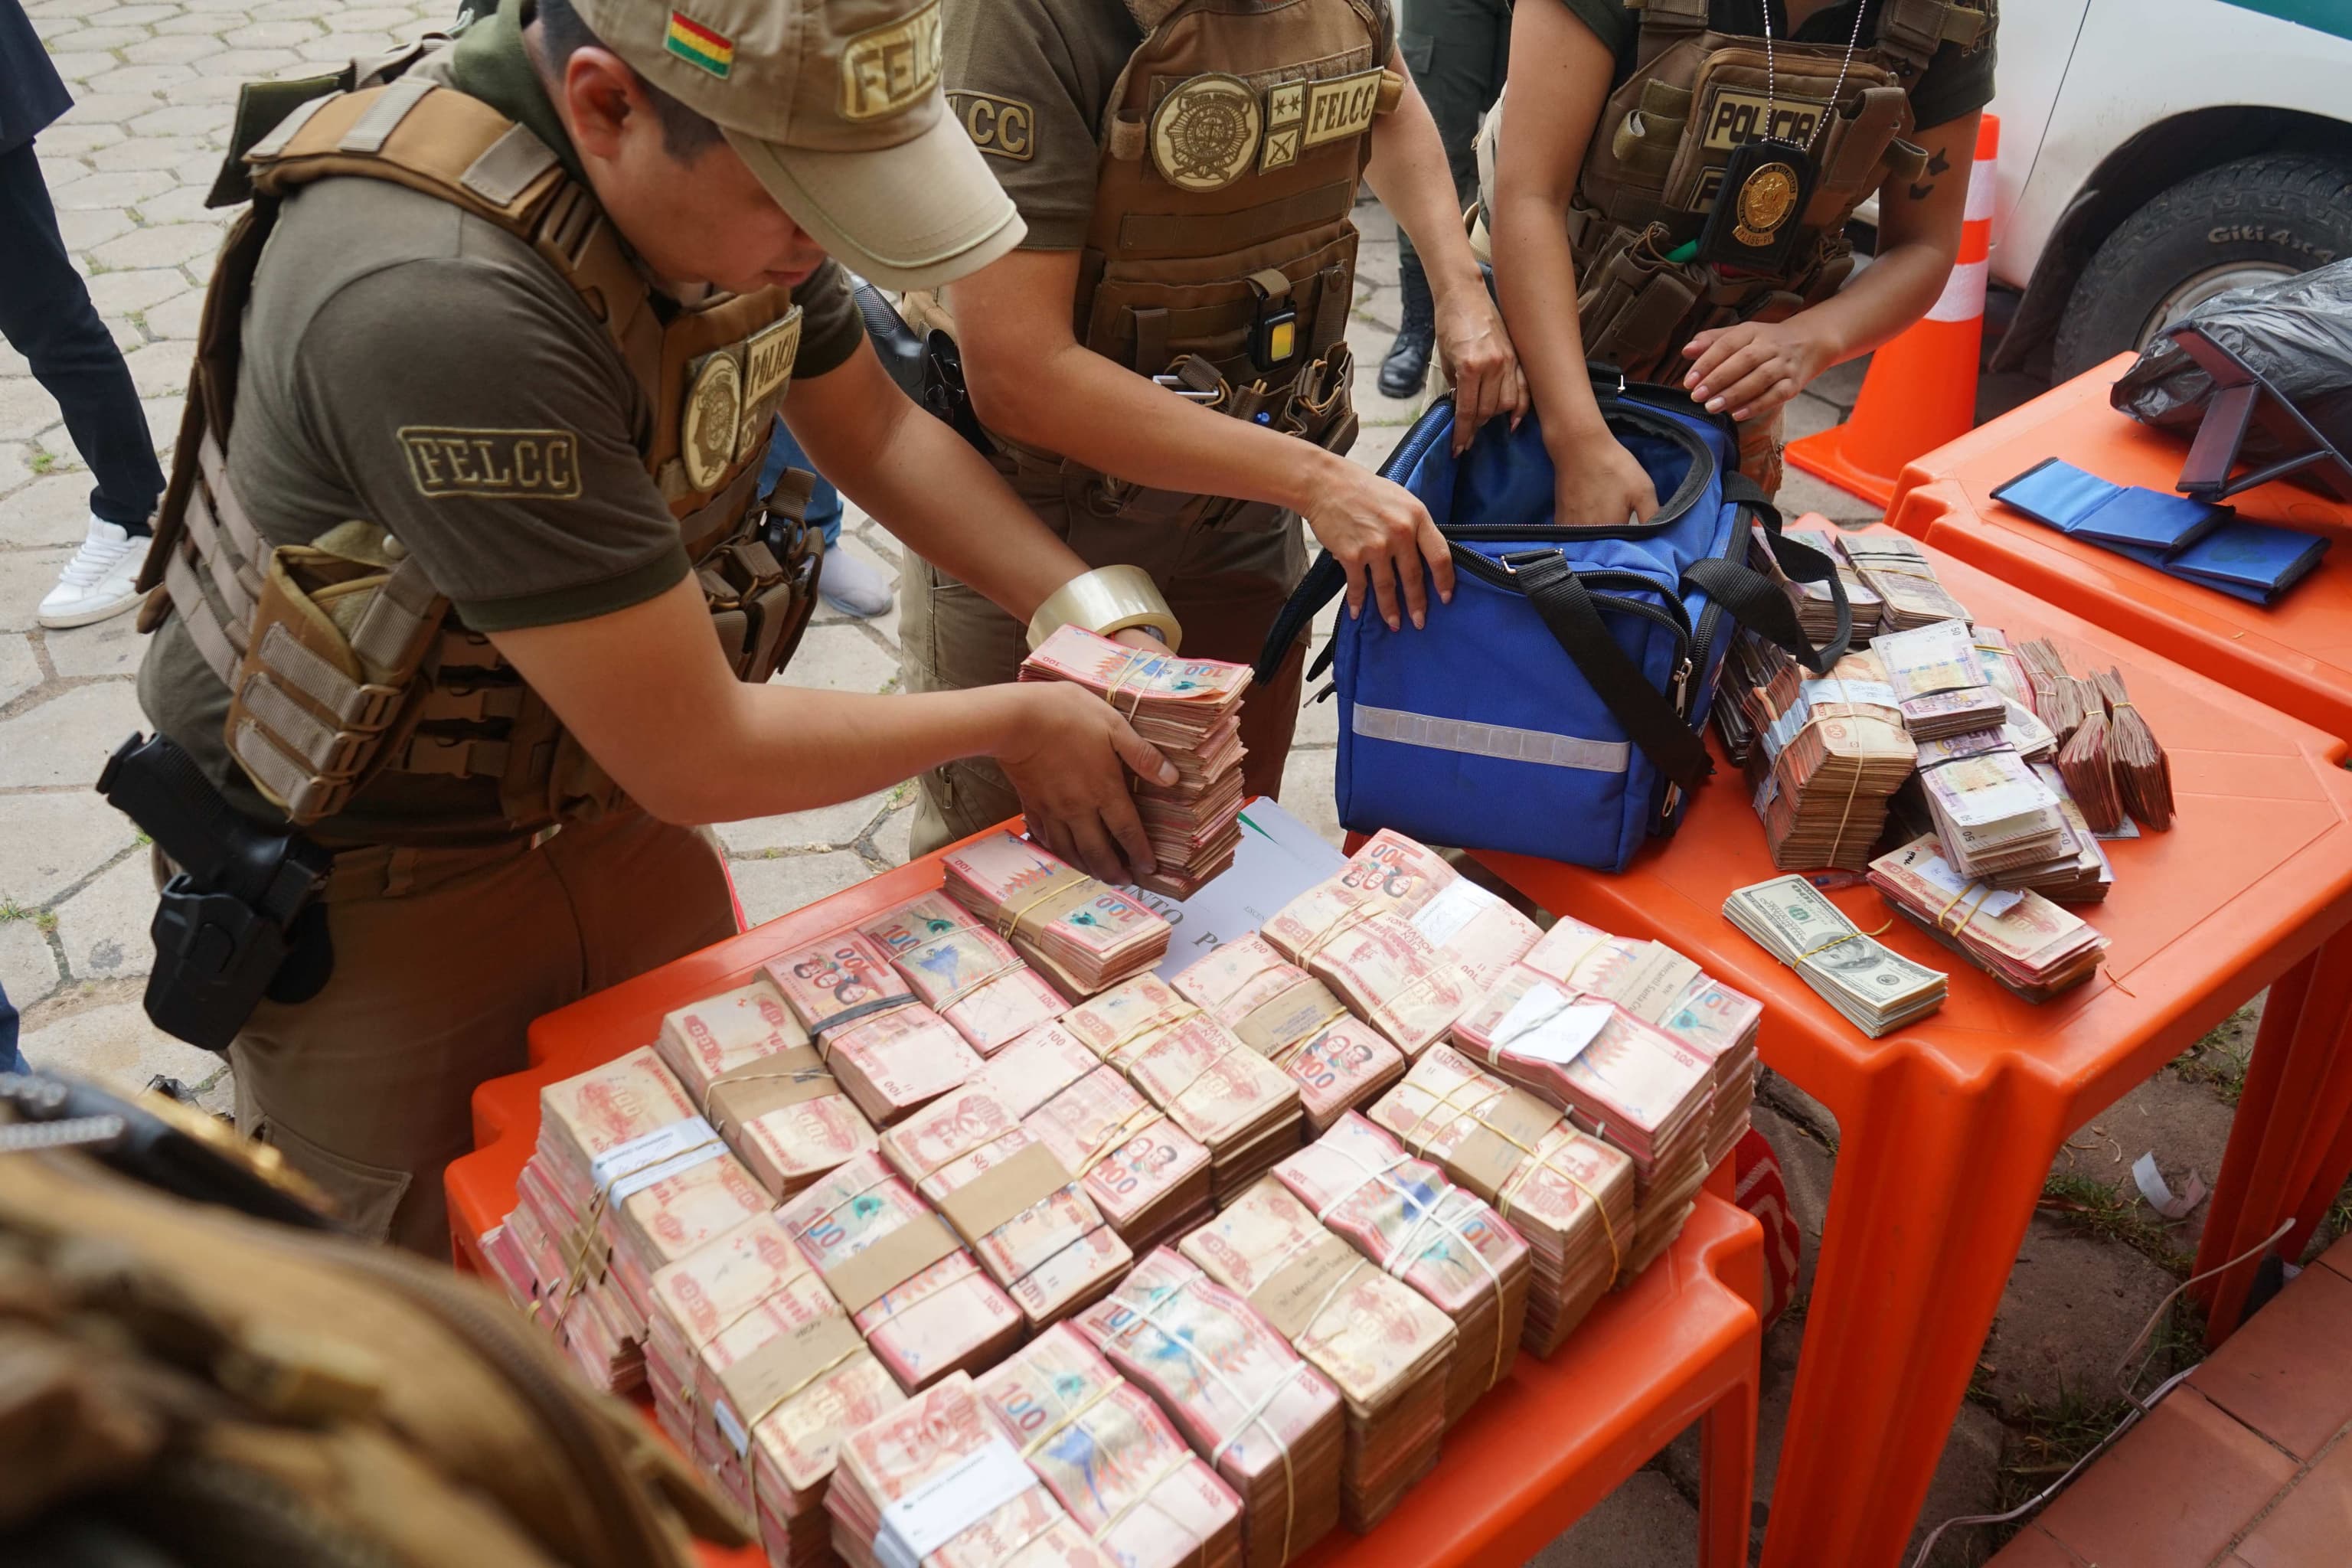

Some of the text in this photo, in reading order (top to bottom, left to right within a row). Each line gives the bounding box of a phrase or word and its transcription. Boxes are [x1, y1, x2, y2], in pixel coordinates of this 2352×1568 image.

[1311, 83, 1374, 135] FELCC
[1710, 102, 1816, 149] POLICIA
[2208, 224, 2266, 243] Giti
[748, 327, 799, 399] POLICIA
[408, 437, 570, 489] FELCC
[1950, 626, 1962, 636] 50
[1184, 665, 1224, 678] 100
[1963, 831, 1975, 843] 50
[955, 858, 972, 873] 100
[1792, 884, 1815, 901] 100
[1096, 897, 1136, 923] 100
[882, 924, 922, 952] 100
[1251, 940, 1268, 955] 100
[1047, 1030, 1066, 1047] 100
[1674, 1049, 1695, 1067] 100
[884, 1080, 902, 1098] 100
[999, 1381, 1047, 1432] 100
